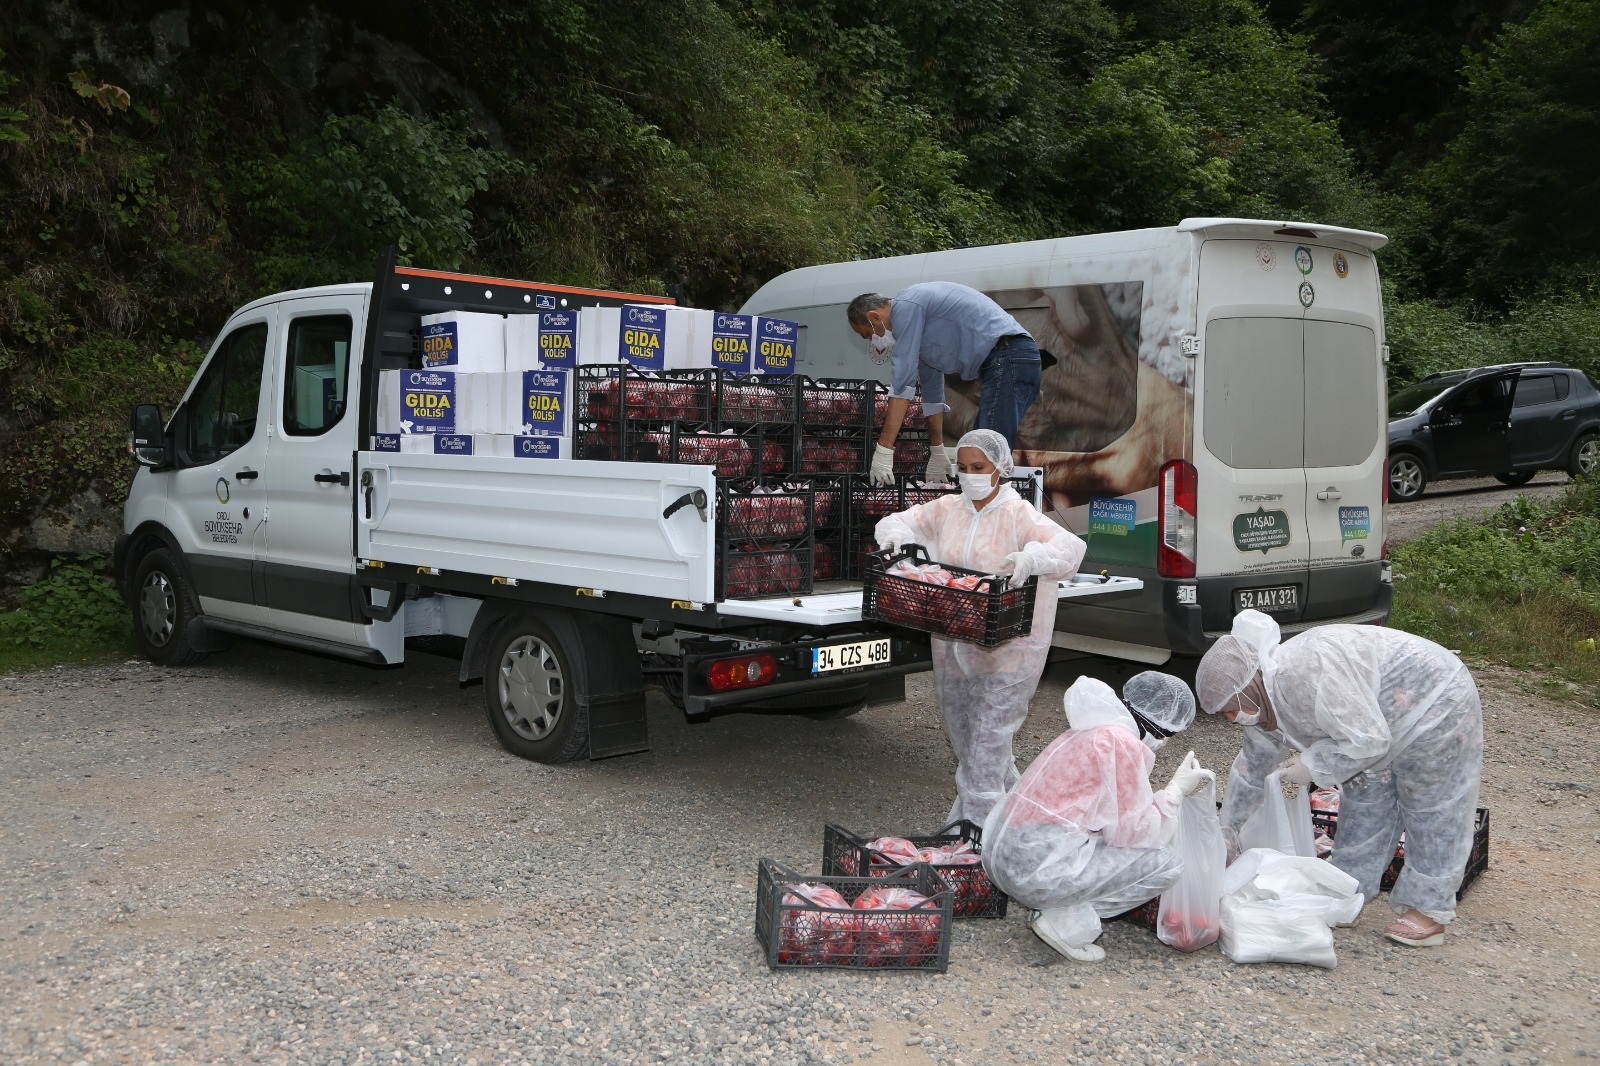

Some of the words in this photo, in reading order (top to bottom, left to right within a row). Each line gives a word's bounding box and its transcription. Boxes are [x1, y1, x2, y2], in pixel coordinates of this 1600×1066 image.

[424, 336, 453, 352] GIDA
[541, 335, 572, 349] GIDA
[624, 330, 660, 349] GIDA
[713, 338, 748, 353] GIDA
[761, 342, 793, 358] GIDA
[405, 394, 451, 409] GIDA
[529, 395, 560, 411] GIDA
[1093, 500, 1134, 512] BÜYÜKŞEHİR
[1246, 516, 1275, 530] YAŞAD
[1240, 592, 1254, 608] 52
[1257, 590, 1277, 607] AAY
[1279, 588, 1296, 605] 321
[820, 649, 834, 669] 34
[841, 645, 862, 666] CZS
[868, 642, 888, 662] 488
